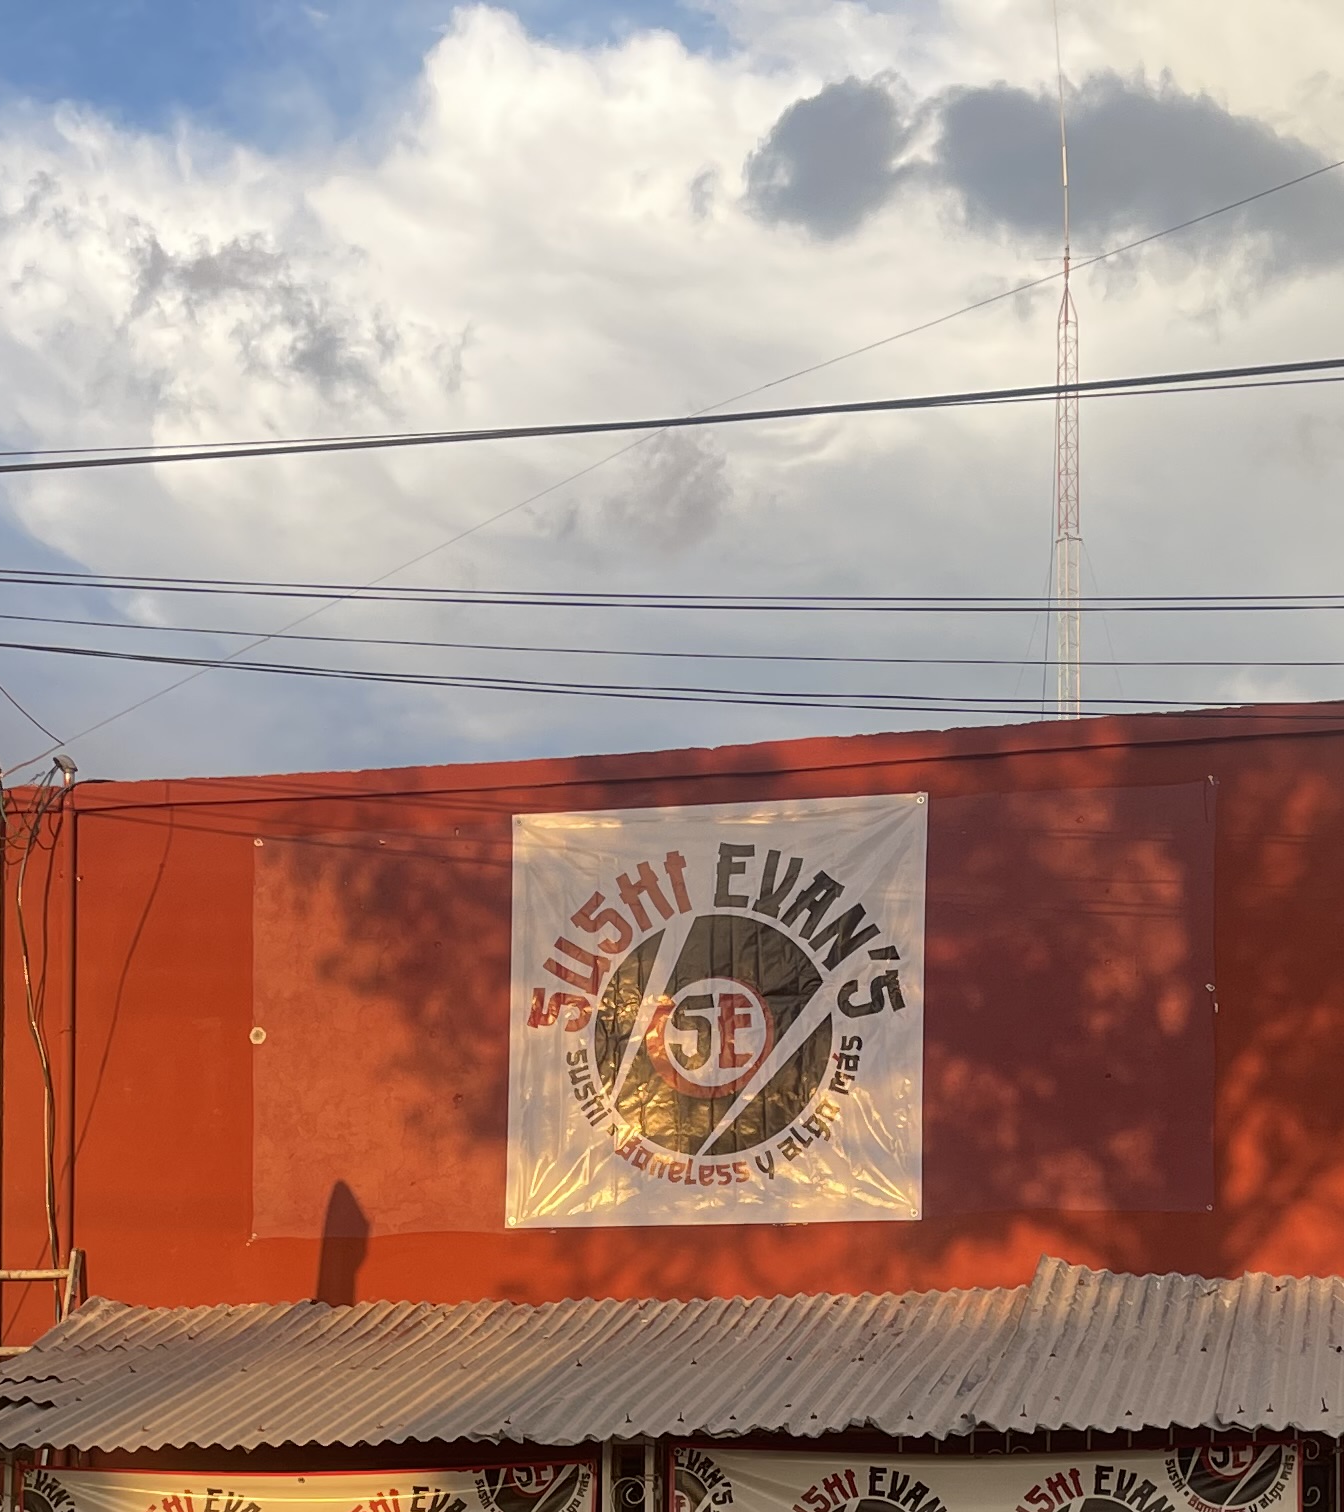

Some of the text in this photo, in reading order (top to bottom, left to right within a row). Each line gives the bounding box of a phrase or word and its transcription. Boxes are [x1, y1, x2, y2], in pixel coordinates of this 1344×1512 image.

[527, 842, 905, 1032] SUSHI EVAN'S
[668, 993, 753, 1071] SE
